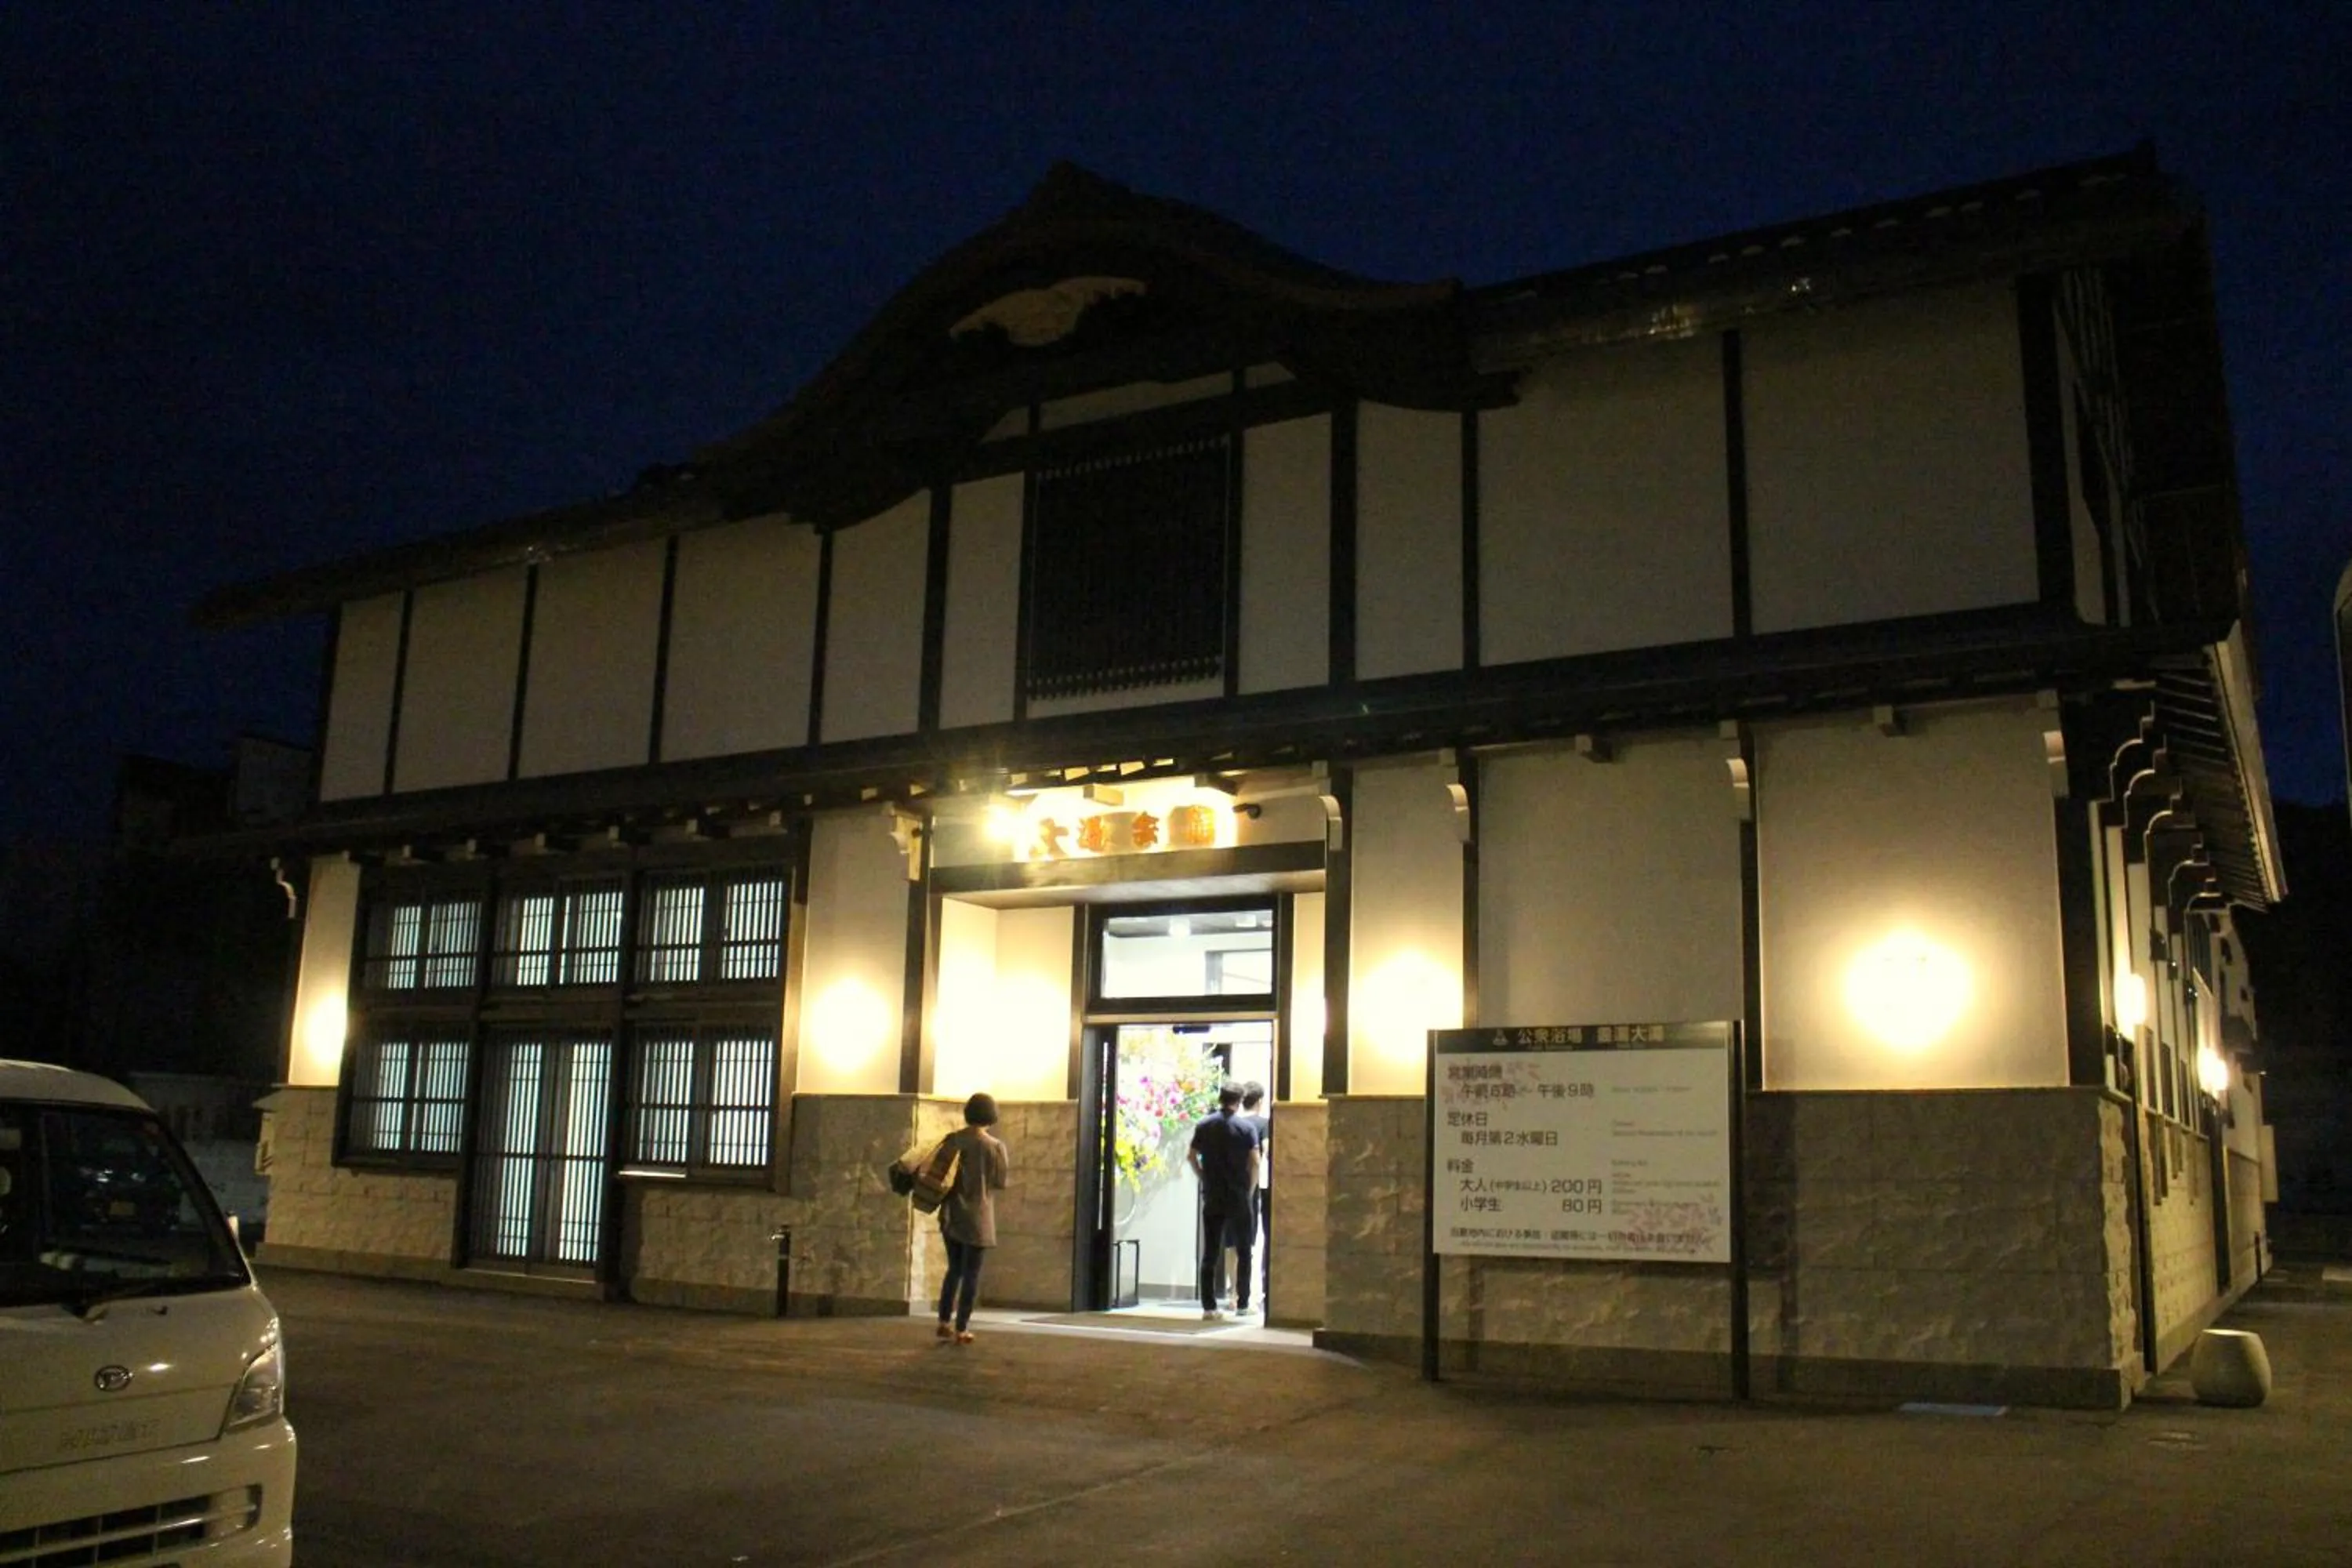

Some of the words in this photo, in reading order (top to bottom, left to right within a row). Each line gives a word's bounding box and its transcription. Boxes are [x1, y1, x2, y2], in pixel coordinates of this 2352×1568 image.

[1518, 1027, 1582, 1044] 公衆浴場
[1447, 1112, 1488, 1127] 定休日
[1446, 1159, 1475, 1174] 料金
[1460, 1196, 1503, 1213] 小学生
